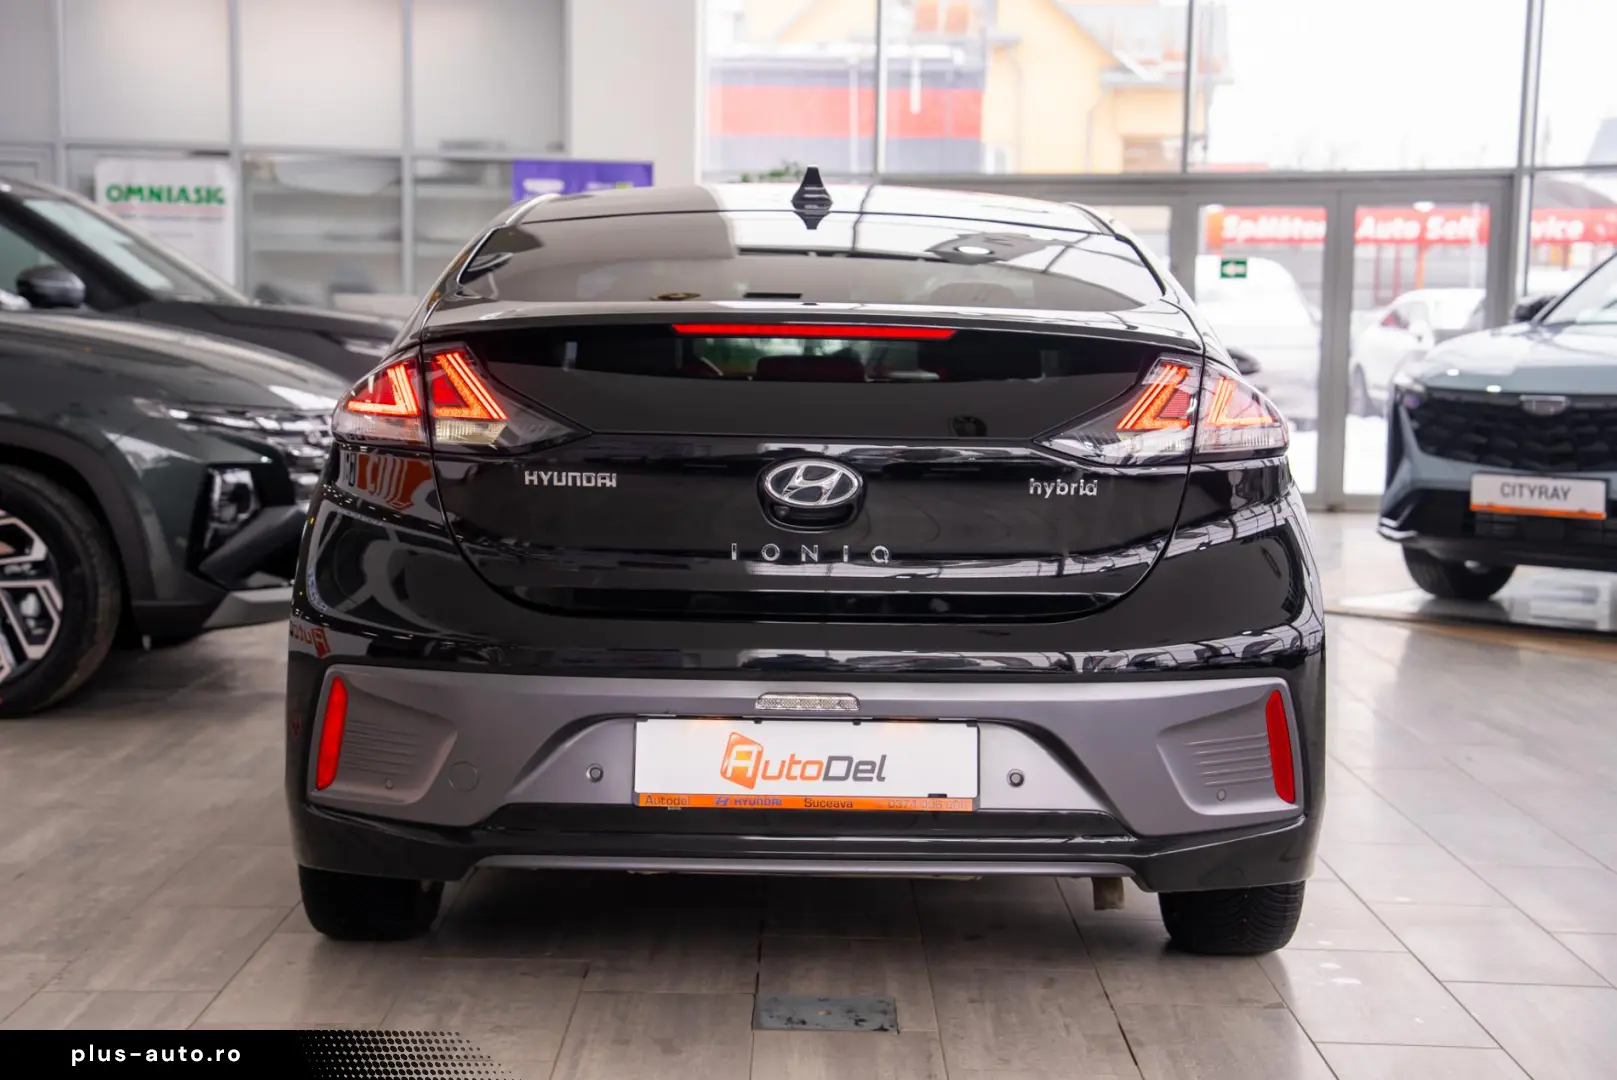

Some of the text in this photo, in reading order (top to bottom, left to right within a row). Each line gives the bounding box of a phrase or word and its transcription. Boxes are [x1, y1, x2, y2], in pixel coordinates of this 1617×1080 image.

[1355, 215, 1421, 240] Auto
[524, 470, 617, 488] HYUNDAI
[1028, 477, 1098, 499] hybrid
[1500, 482, 1571, 501] CITYRAY
[731, 542, 890, 564] IONIQ
[720, 731, 888, 790] AutoDel
[644, 794, 691, 807] Autodel
[733, 795, 783, 807] HYUNDAI
[804, 797, 853, 809] Suceava
